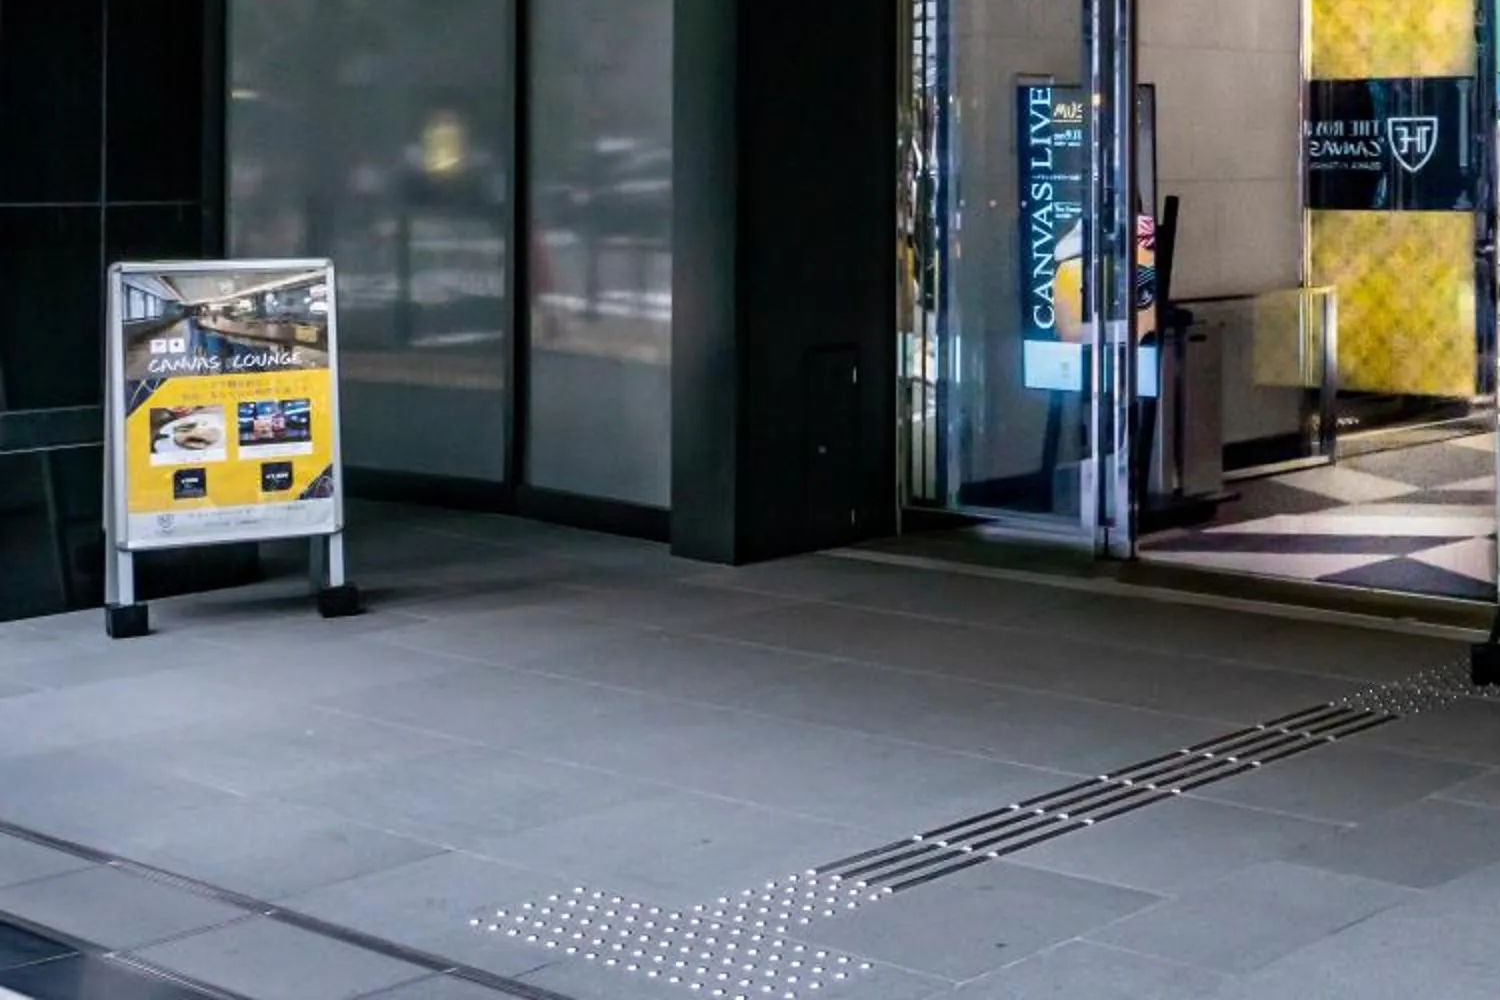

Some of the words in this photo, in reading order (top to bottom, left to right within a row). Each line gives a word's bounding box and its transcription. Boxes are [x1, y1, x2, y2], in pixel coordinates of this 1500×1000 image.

[1030, 86, 1053, 170] LIVE
[1030, 182, 1055, 330] CANVAS
[148, 353, 221, 373] CANVAS
[231, 351, 304, 368] LOUNGE
